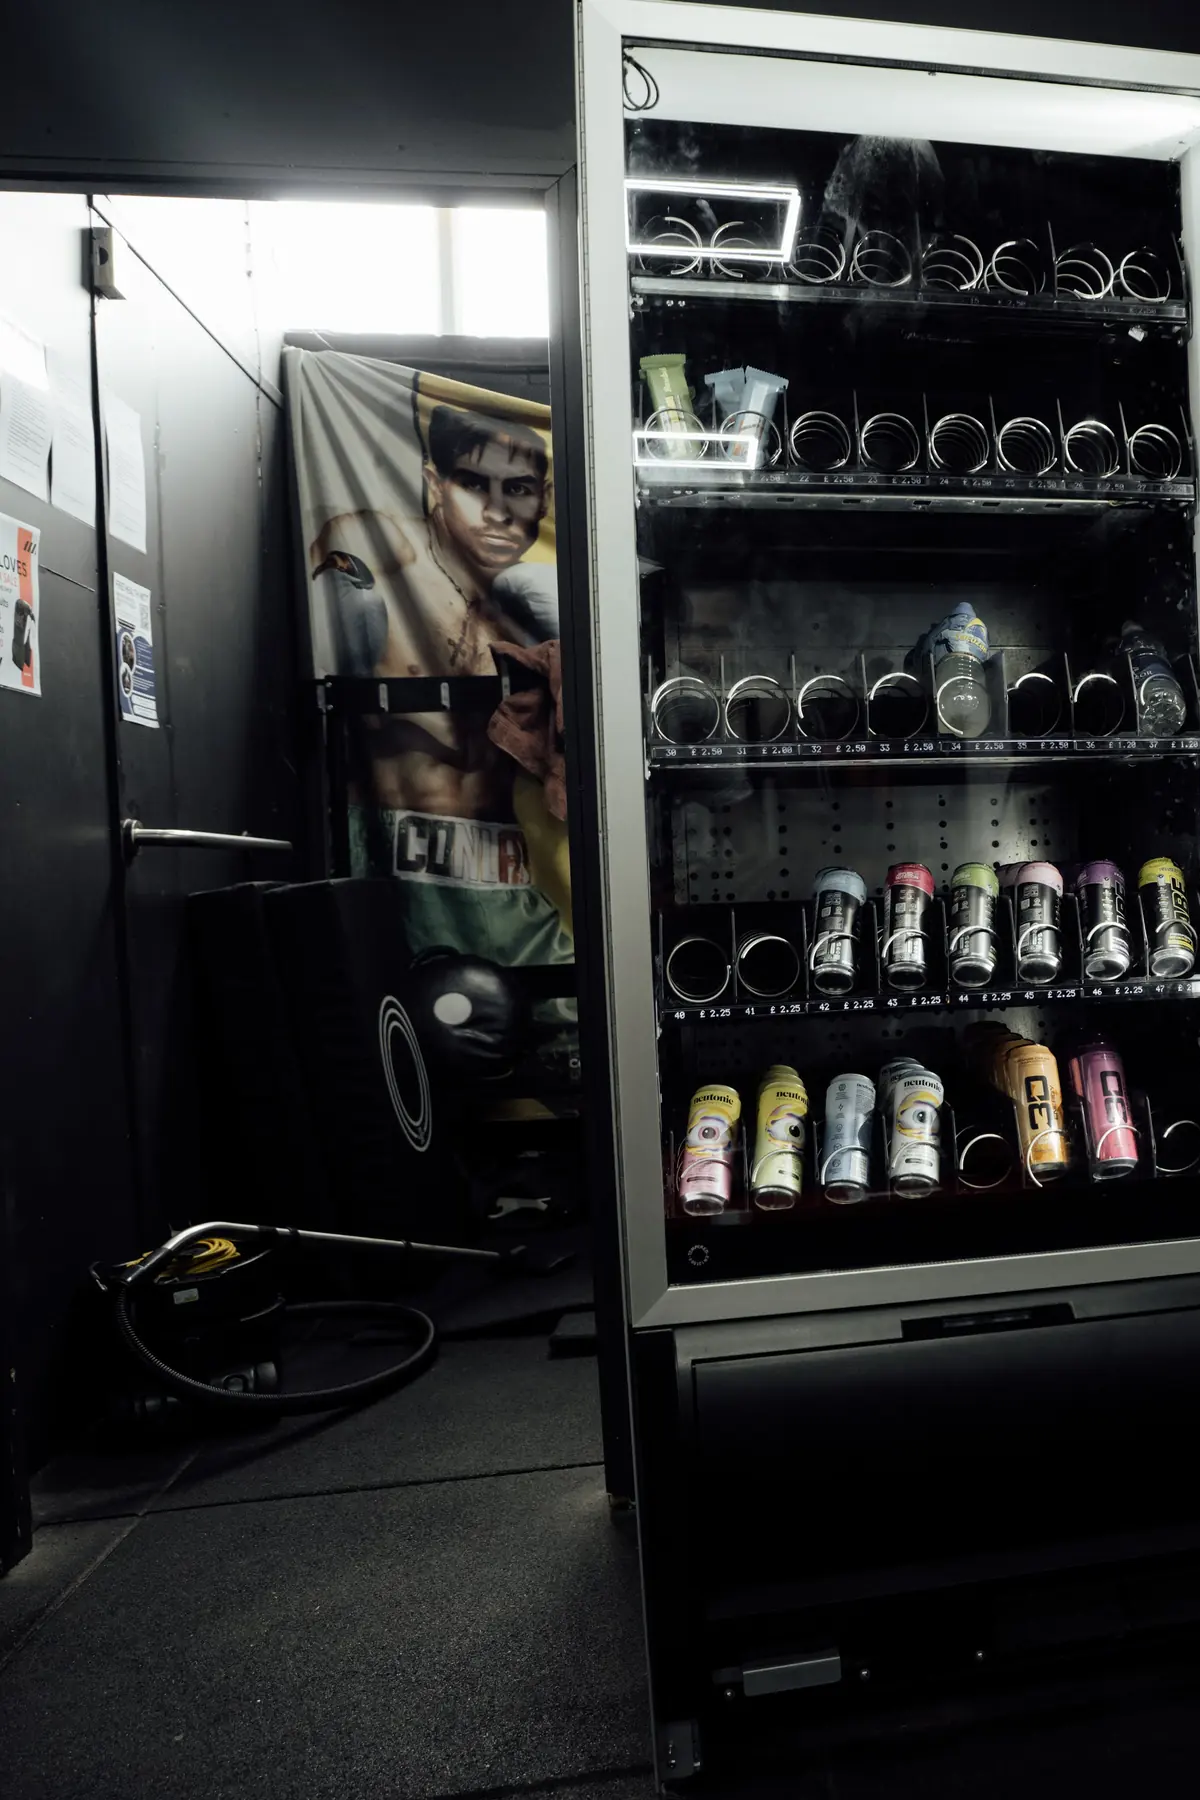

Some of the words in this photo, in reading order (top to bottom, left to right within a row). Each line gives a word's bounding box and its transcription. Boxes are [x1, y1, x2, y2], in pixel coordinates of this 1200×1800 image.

[798, 475, 810, 483] 22
[832, 475, 854, 484] 2.50
[901, 477, 922, 485] 2.50
[971, 479, 992, 487] 2.50
[1037, 481, 1057, 489] 2.50
[811, 745, 822, 753] 32
[845, 744, 866, 753] 2.50
[879, 744, 891, 752] 33
[913, 743, 934, 751] 2.50
[951, 742, 962, 751] 34
[984, 742, 1004, 750] 2.50
[1017, 742, 1028, 750] 35
[1049, 741, 1070, 749] 2.50
[1086, 741, 1096, 749] 36
[1117, 741, 1137, 749] 1.20
[1180, 740, 1199, 748] 1.20
[665, 748, 677, 757] 30
[701, 747, 723, 756] 2.50
[736, 747, 747, 755] 31
[772, 746, 793, 754] 2.00
[398, 815, 532, 885] CONLA
[958, 994, 969, 1003] 44
[991, 992, 1012, 1001] 2.25
[1024, 991, 1035, 999] 45
[1056, 989, 1076, 998] 2.25
[1092, 988, 1103, 996] 46
[1124, 986, 1143, 994] 2.25
[1155, 985, 1165, 993] 47
[819, 1002, 830, 1011] 42
[853, 1000, 874, 1009] 2.25
[887, 998, 898, 1007] 43
[921, 995, 942, 1005] 2.25
[674, 1011, 686, 1020] 40
[709, 1008, 731, 1018] 2.25
[745, 1007, 755, 1015] 41
[780, 1004, 801, 1013] 2.25
[904, 1079, 942, 1093] neutonic
[693, 1093, 734, 1105] neutonic
